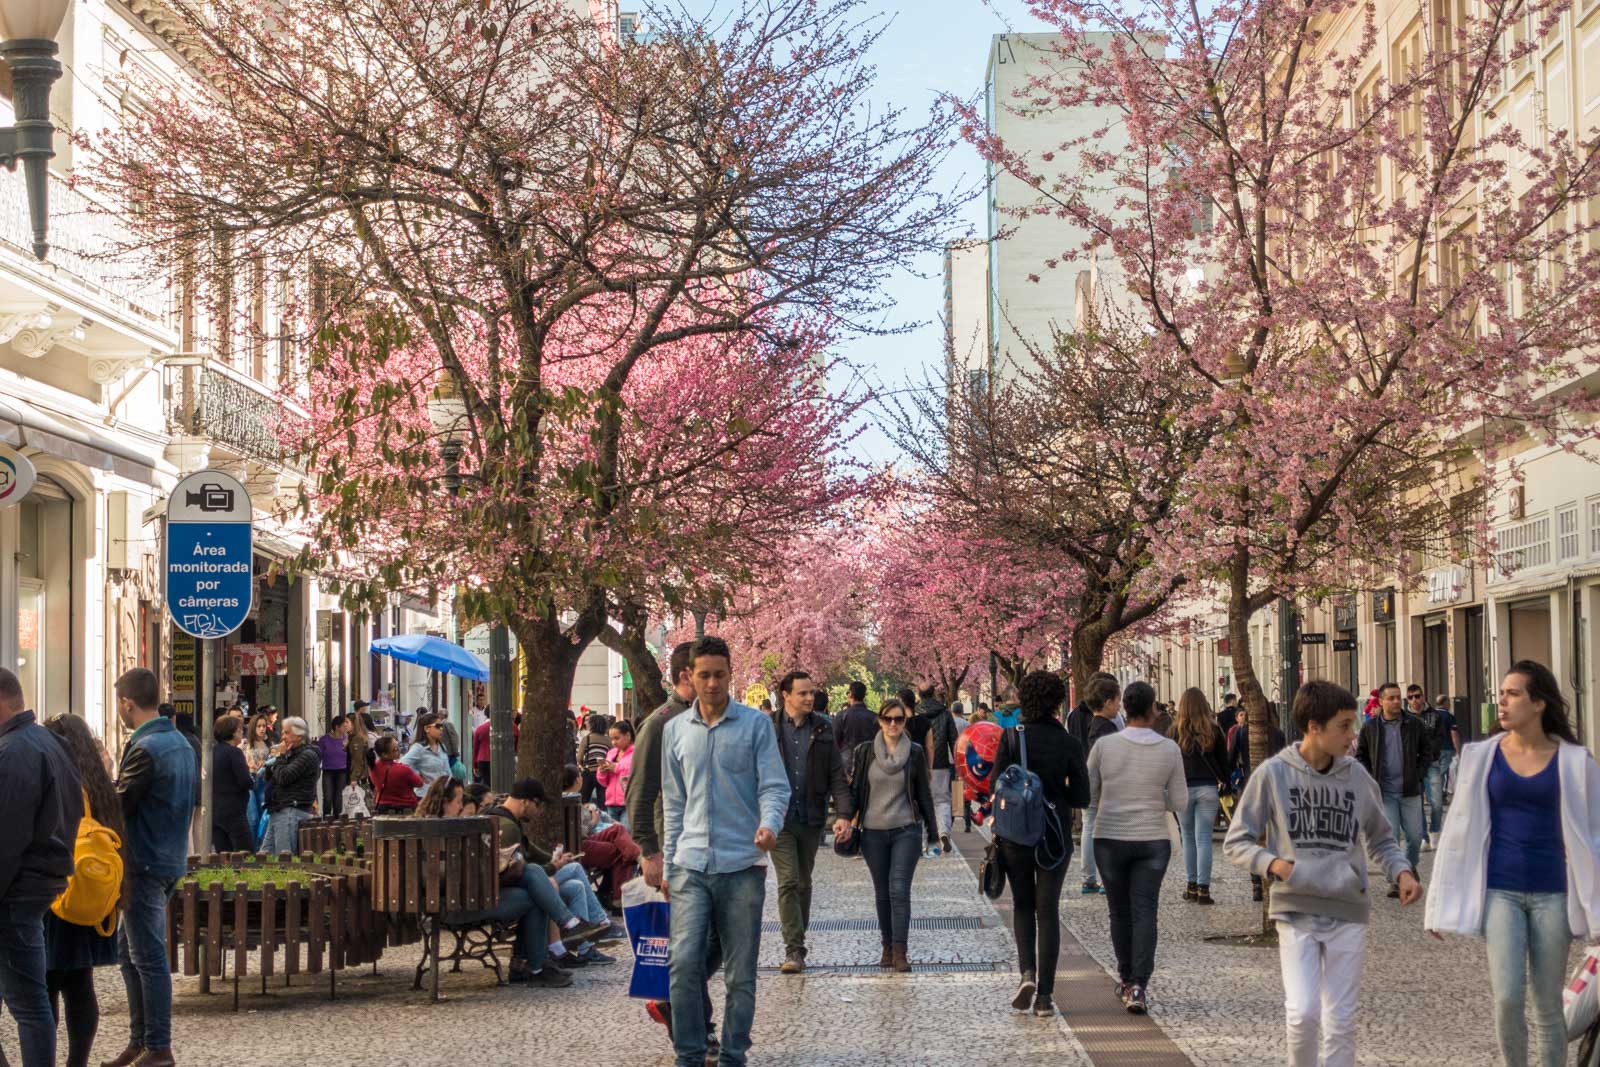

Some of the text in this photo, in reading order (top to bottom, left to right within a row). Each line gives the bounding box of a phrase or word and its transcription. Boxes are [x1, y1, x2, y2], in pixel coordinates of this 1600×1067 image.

[193, 541, 226, 556] Área
[169, 561, 249, 573] monitorada
[196, 580, 221, 592] por
[178, 595, 239, 608] câmeras
[1287, 808, 1359, 840] DIVISION
